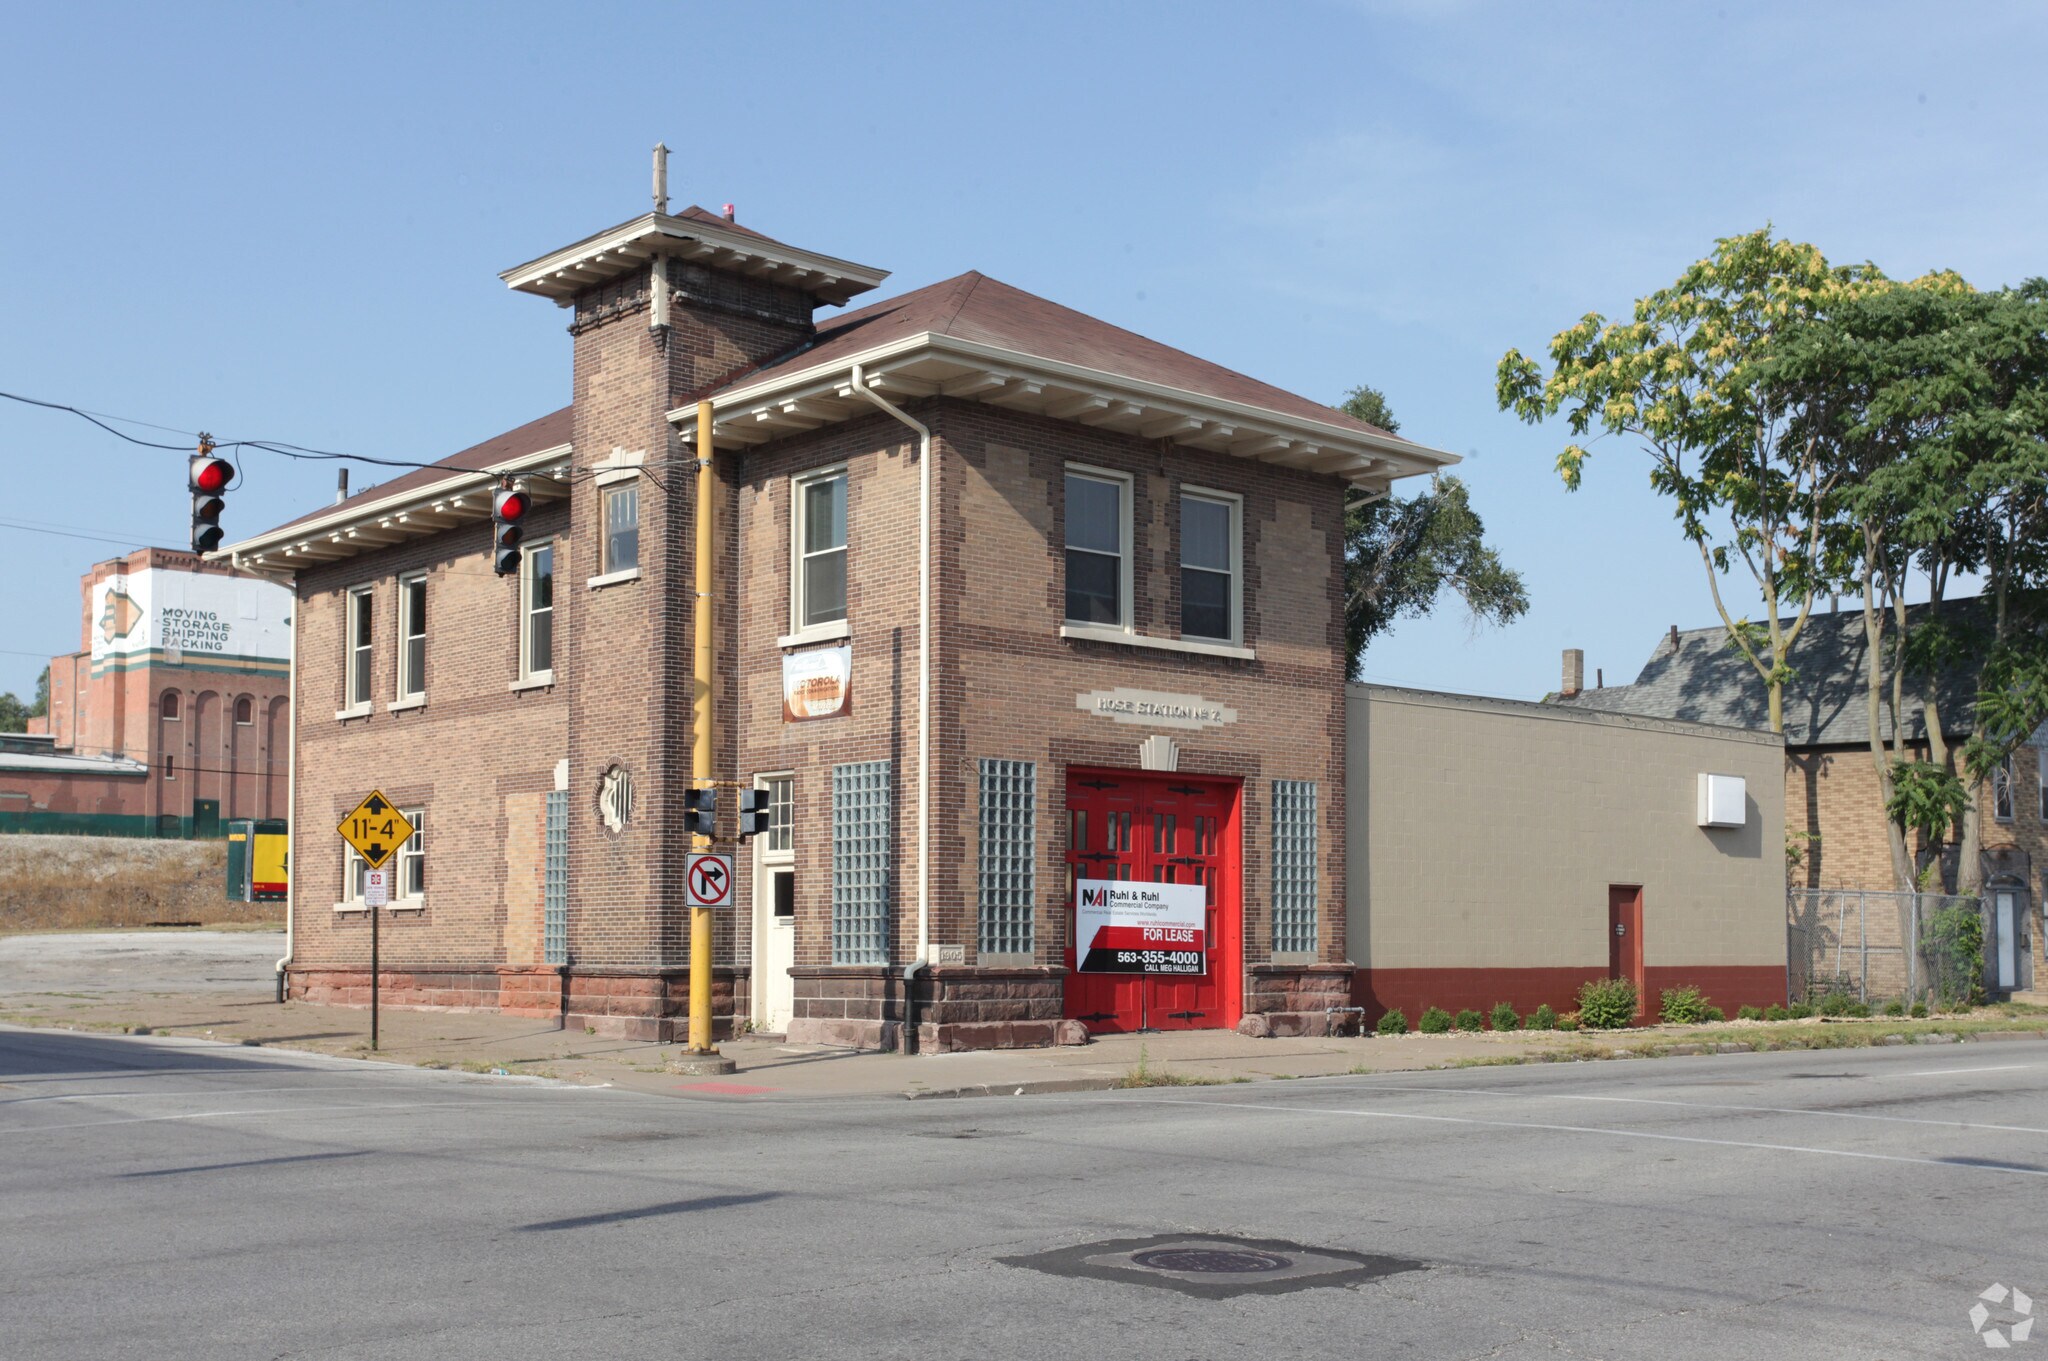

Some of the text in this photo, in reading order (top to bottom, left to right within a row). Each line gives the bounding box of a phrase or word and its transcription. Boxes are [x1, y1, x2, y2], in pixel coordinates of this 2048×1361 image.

[162, 608, 217, 621] MOVING
[162, 618, 230, 632] STORAGE
[162, 628, 228, 641] SHIPPING
[162, 637, 222, 650] PACKING
[1097, 697, 1134, 713] HOSE
[1137, 701, 1190, 718] STATION
[1082, 885, 1107, 907] NAI
[1110, 890, 1160, 901] Ruhl & Ruhl
[1109, 900, 1169, 911] Commercial Company
[1137, 920, 1196, 928] www.ruhlcommercial.com
[1143, 928, 1194, 942] FOR LEASE
[940, 950, 963, 961] 1905
[1117, 950, 1199, 964] 563-355-4000
[1144, 964, 1159, 972] CALL
[1173, 965, 1199, 973] HALLIGAN
